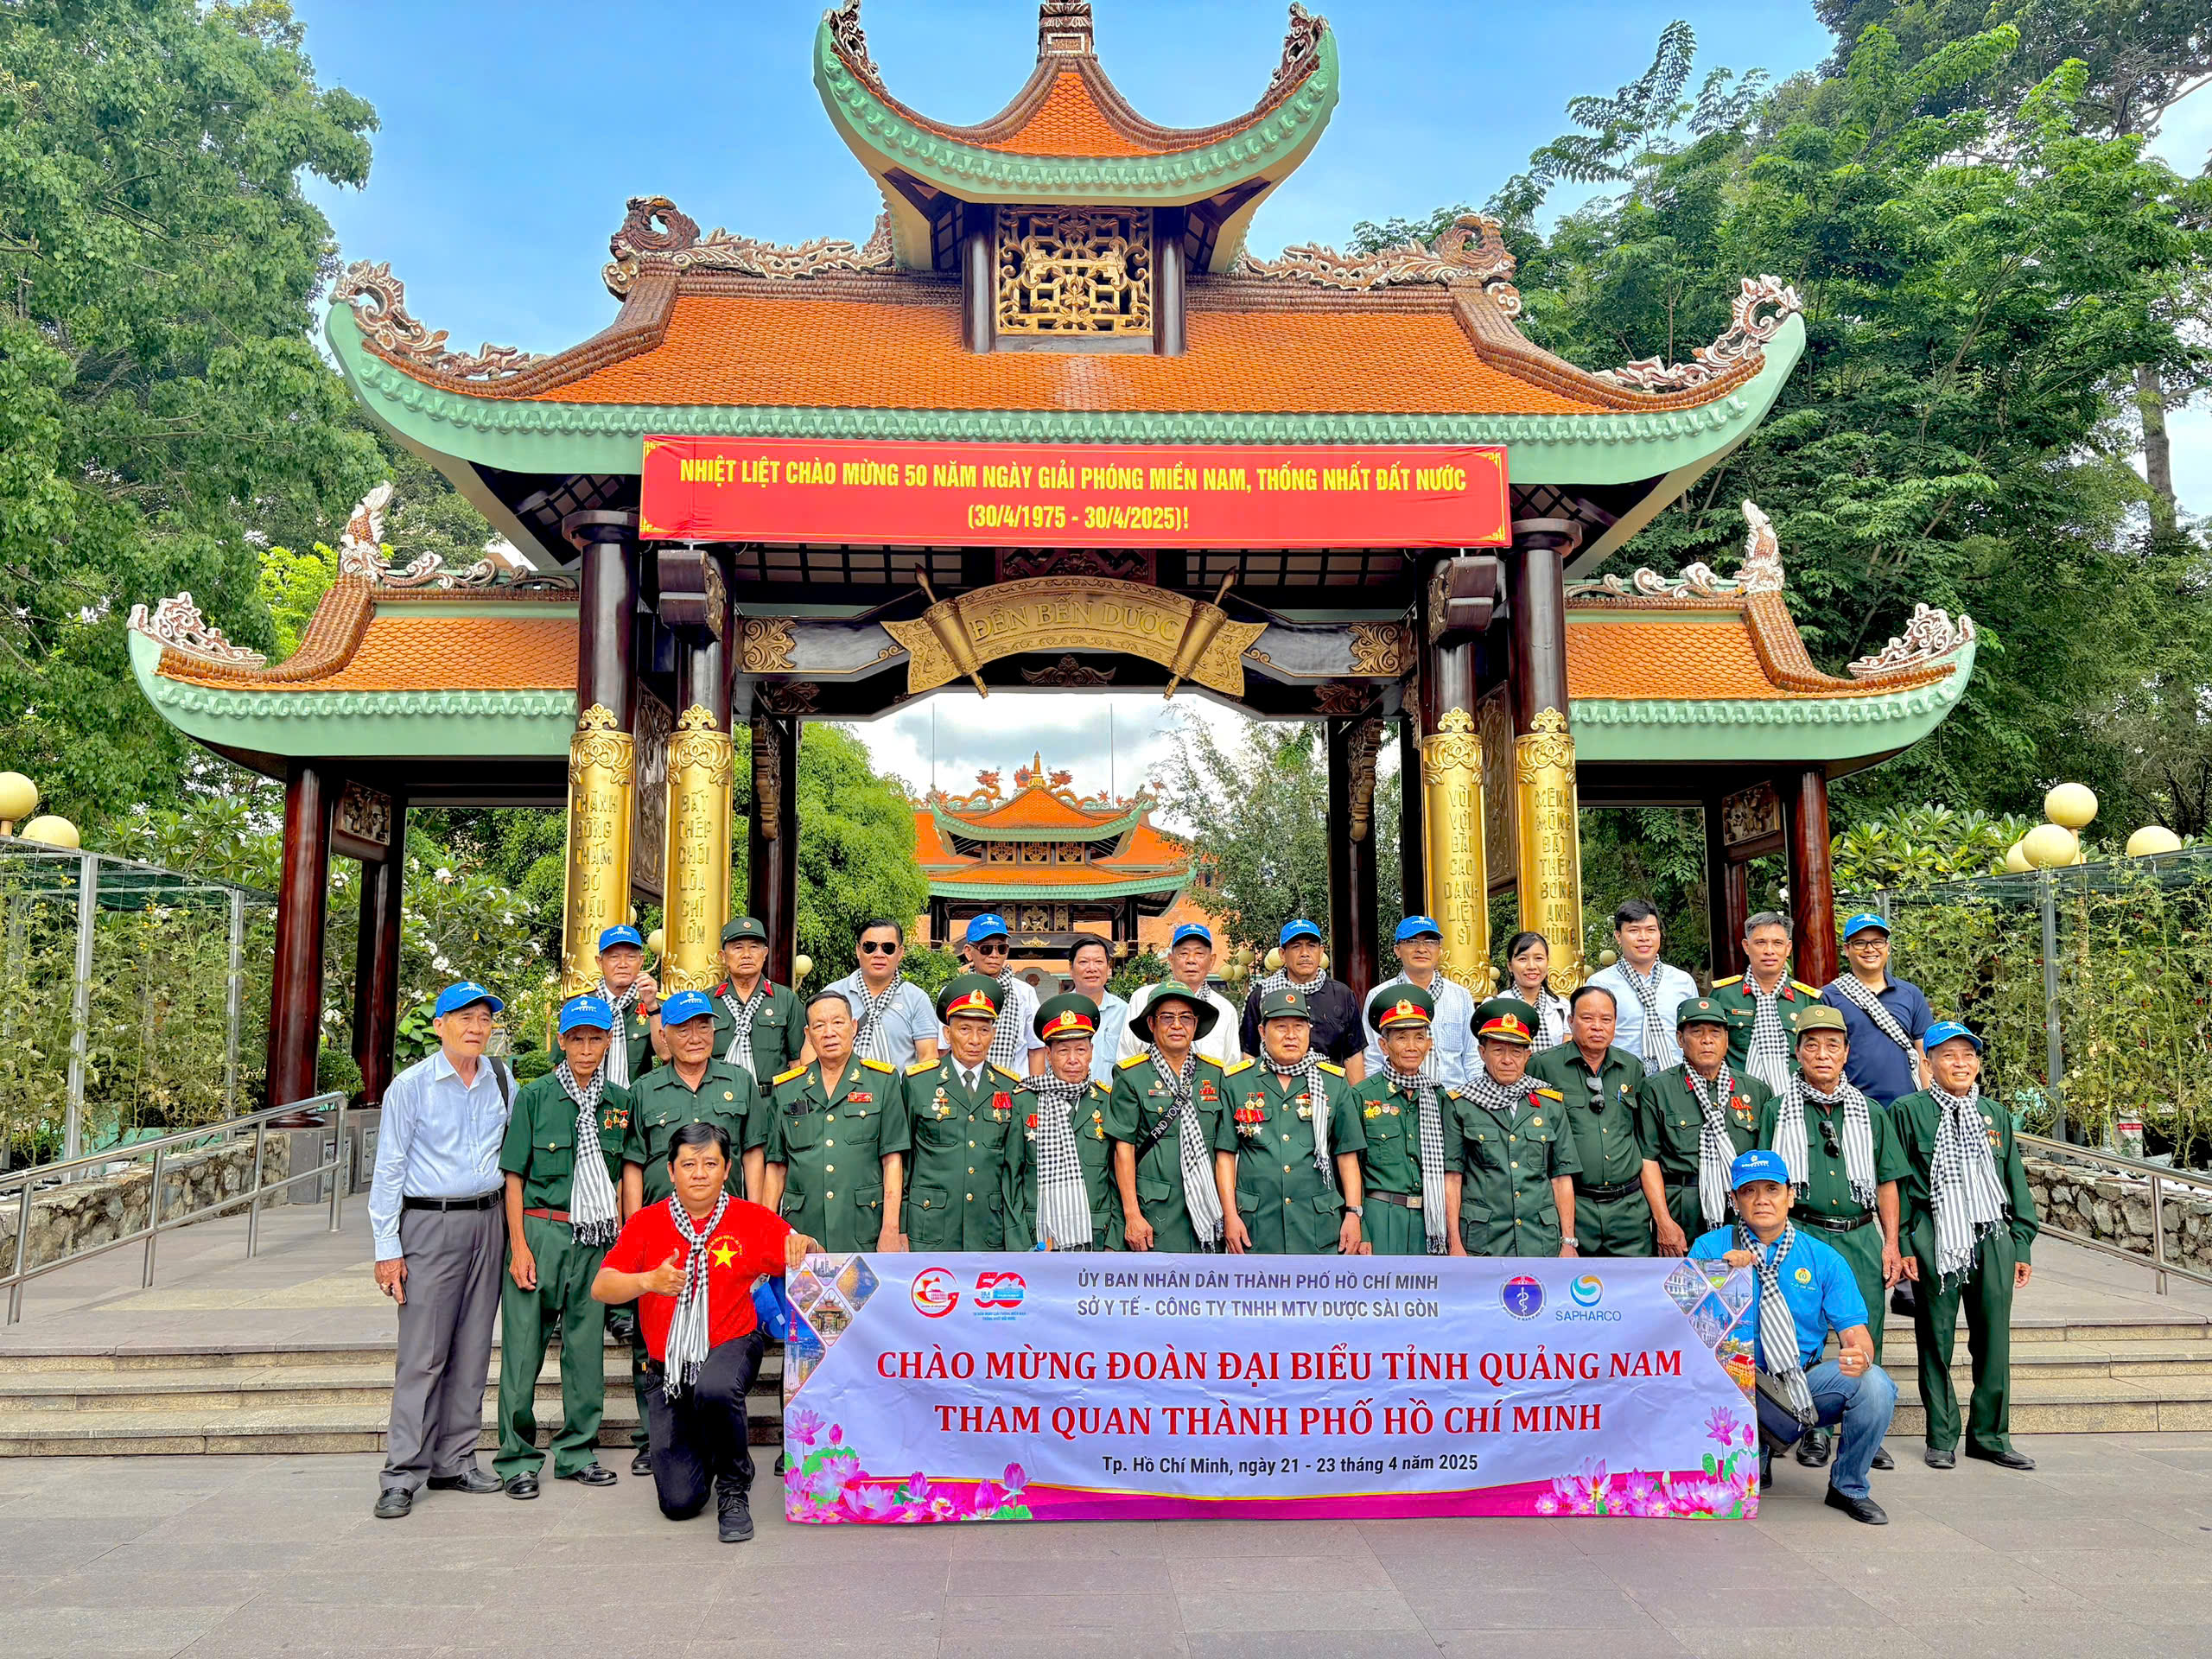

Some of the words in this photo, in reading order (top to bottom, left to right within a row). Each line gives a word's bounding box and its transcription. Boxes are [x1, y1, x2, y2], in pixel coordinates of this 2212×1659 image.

[680, 457, 736, 487] NHIỆT
[742, 456, 779, 489] LIỆT
[786, 457, 836, 485] CHÀO
[842, 458, 899, 486] MỪNG
[905, 464, 927, 486] 50
[933, 461, 976, 487] NĂM
[982, 461, 1033, 489] NGÀY
[1039, 460, 1074, 490] GIẢI
[1082, 461, 1143, 490] PHÓNG
[1150, 461, 1198, 490] MIỀN
[1203, 468, 1251, 493] NAM,
[1257, 461, 1317, 491] THỐNG
[1323, 461, 1370, 491] NHẤT
[1376, 461, 1409, 491] ĐẤT
[1416, 461, 1465, 491] NƯỚC
[968, 505, 1065, 530] (30/4/1975
[1084, 506, 1189, 531] 30/4/2025)!
[1036, 594, 1094, 626] BẾN
[1449, 857, 1473, 876] CAO
[1546, 904, 1573, 922] ANH
[574, 923, 604, 945] TƯƠ
[1150, 1120, 1168, 1139] FIND
[974, 1271, 1027, 1309] 50
[1078, 1268, 1099, 1287] ỦY
[1104, 1273, 1138, 1287] BAN
[1143, 1270, 1190, 1287] NHÂN
[1195, 1270, 1229, 1288] DÂN
[1234, 1271, 1290, 1288] THÀNH
[1296, 1271, 1330, 1288] PHỐ
[1335, 1271, 1357, 1288] HỒ
[1363, 1272, 1391, 1289] CHÍ
[1395, 1275, 1438, 1289] MINH
[1077, 1294, 1099, 1316] SỞ
[1104, 1300, 1114, 1316] Y
[1120, 1295, 1141, 1316] TẾ
[1155, 1297, 1200, 1316] CÔNG
[1206, 1300, 1226, 1316] TY
[1231, 1300, 1276, 1316] TNHH
[1282, 1301, 1317, 1316] MTV
[1323, 1301, 1368, 1319] DƯỢC
[1373, 1299, 1399, 1317] SÀI
[1404, 1299, 1438, 1317] GÒN
[1556, 1310, 1622, 1322] SAPHARCO
[877, 1344, 975, 1379] CHÀO
[985, 1344, 1095, 1380] MỪNG
[1107, 1344, 1207, 1380] ĐOÀN
[1218, 1351, 1279, 1387] ĐẠI
[1290, 1343, 1371, 1380] BIỂU
[1382, 1344, 1468, 1380] TỈNH
[1479, 1344, 1599, 1387] QUẢNG
[1609, 1350, 1681, 1377] NAM
[934, 1406, 1040, 1433] THAM
[1052, 1407, 1150, 1440] QUAN
[1162, 1399, 1287, 1435] THÀNH
[1299, 1398, 1373, 1435] PHỐ
[1383, 1398, 1433, 1434] HỒ
[1444, 1399, 1501, 1433] CHÍ
[1513, 1404, 1601, 1433] MINH
[1103, 1457, 1127, 1474] Tp.
[1133, 1456, 1154, 1472] Hồ
[1160, 1458, 1186, 1473] Chí
[1191, 1458, 1233, 1476] Minh,
[1239, 1458, 1275, 1476] ngày
[1281, 1459, 1298, 1473] 21
[1317, 1458, 1335, 1472] 23
[1340, 1457, 1382, 1474] tháng
[1389, 1457, 1397, 1470] 4
[1402, 1456, 1433, 1469] năm
[1439, 1455, 1478, 1470] 2025
